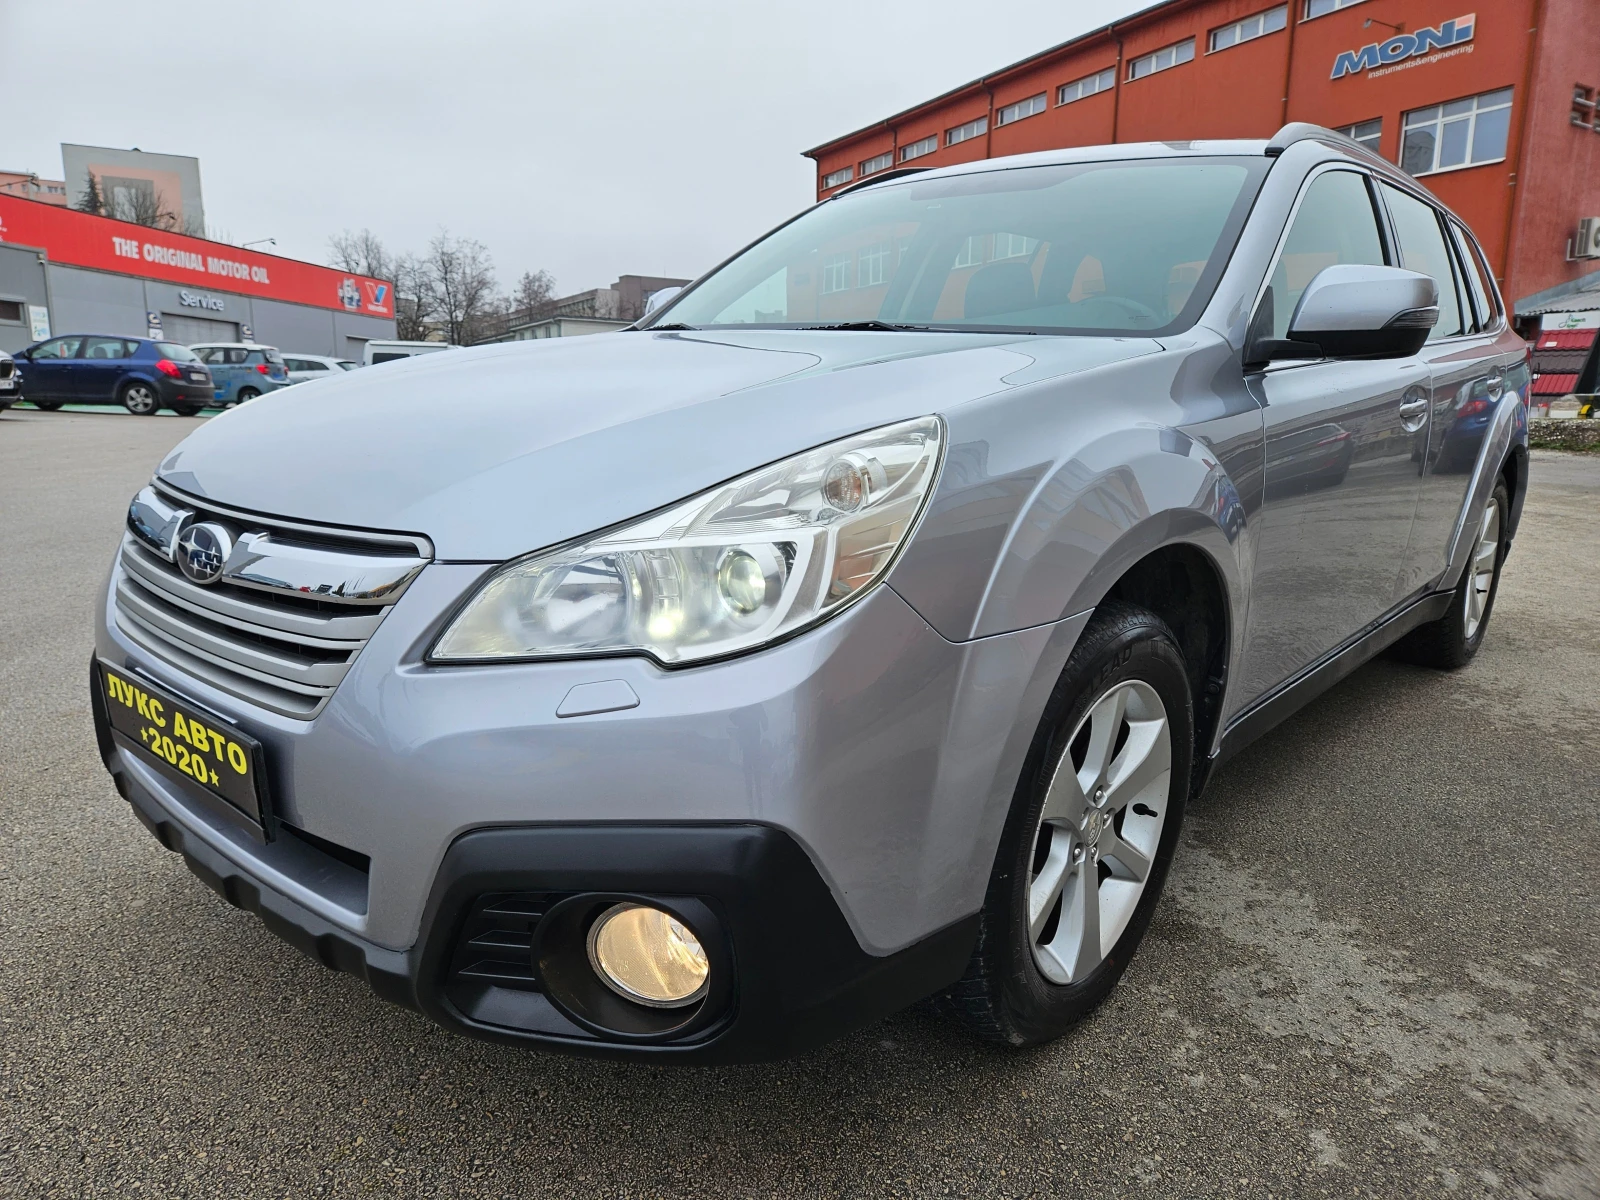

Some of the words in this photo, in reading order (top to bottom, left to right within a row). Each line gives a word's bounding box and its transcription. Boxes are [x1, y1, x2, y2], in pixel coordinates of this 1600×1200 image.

[1368, 44, 1474, 79] instruments&engineering
[112, 236, 140, 259] THE
[143, 243, 205, 272] ORIGINAL
[207, 256, 250, 280] MOTOR
[251, 265, 270, 284] OIL
[179, 290, 225, 311] Service
[107, 673, 166, 728] ЛУКС
[173, 711, 248, 775] АВТО
[148, 727, 209, 784] 2020
